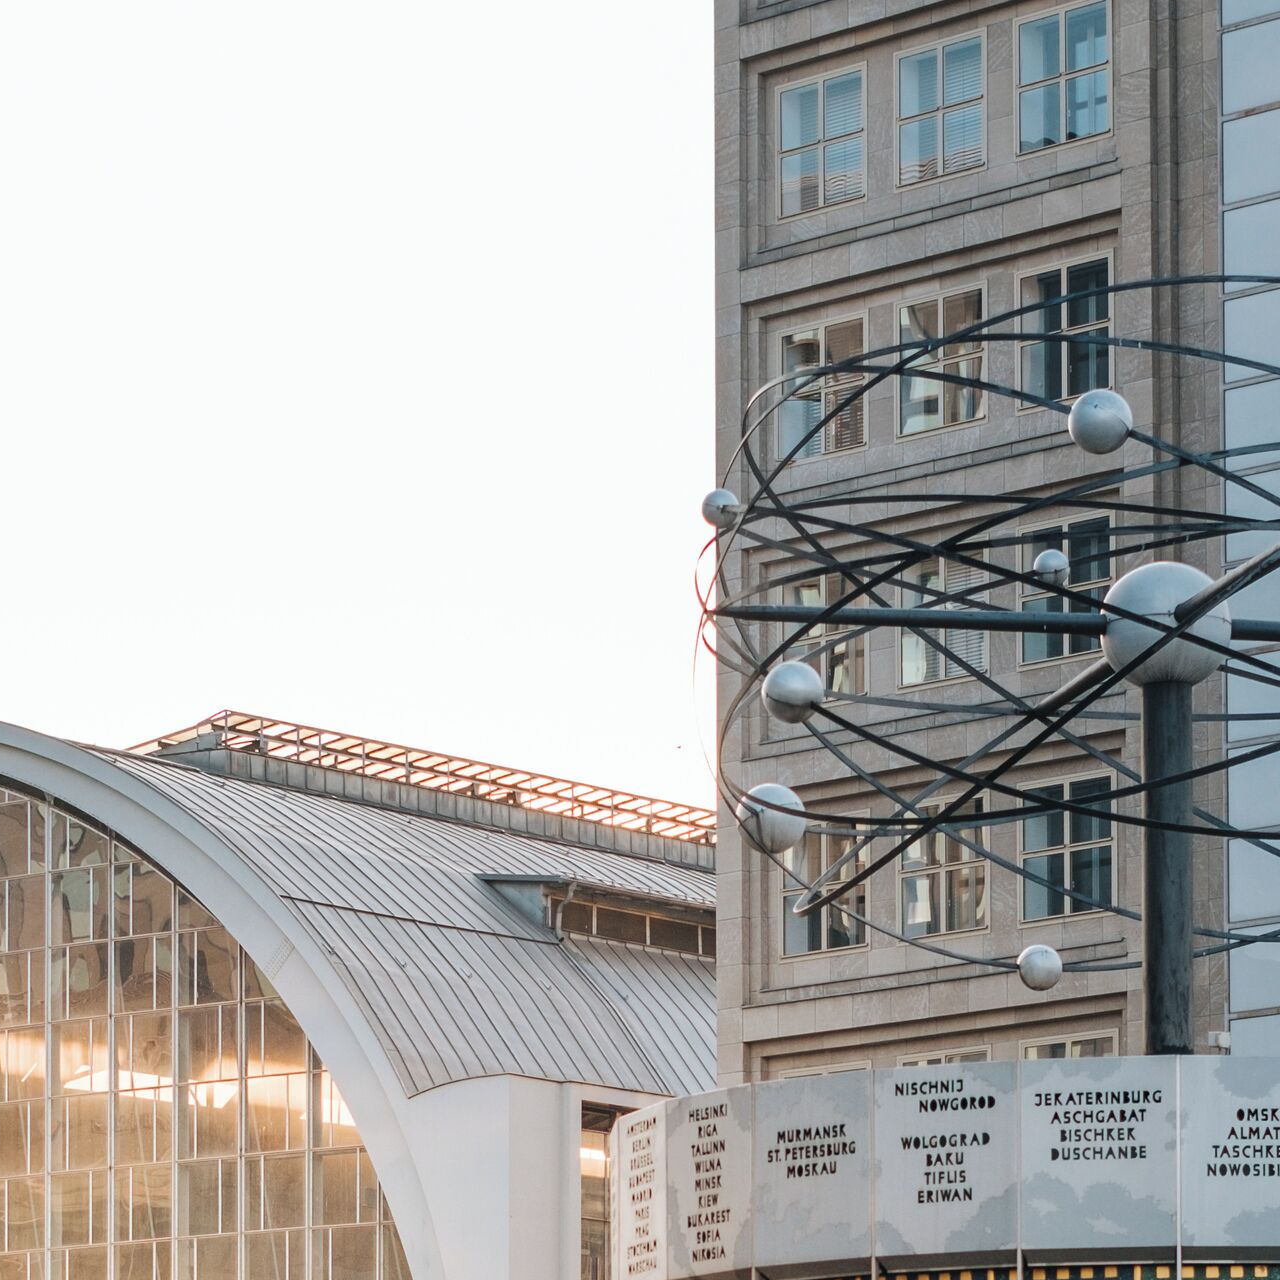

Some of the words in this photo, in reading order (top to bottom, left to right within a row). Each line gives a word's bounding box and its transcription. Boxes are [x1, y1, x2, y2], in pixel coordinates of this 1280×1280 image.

[895, 1079, 964, 1097] NISCHNIJ
[919, 1095, 996, 1113] NOWGOROD
[1034, 1089, 1162, 1107] JEKATERINBURG
[688, 1104, 728, 1122] HELSINKI
[1050, 1109, 1147, 1125] ASCHGABAT
[1237, 1108, 1280, 1122] OMSK
[698, 1126, 718, 1139] RIGA
[776, 1124, 847, 1144] MURMANSK
[901, 1132, 990, 1150] WOLGOGRAD
[1060, 1127, 1136, 1142] BISCHKEK
[691, 1140, 726, 1157] TALLINN
[767, 1149, 782, 1163] ST.
[785, 1141, 856, 1161] PETERSBURG
[1050, 1145, 1147, 1161] DUSCHANBE
[695, 1159, 722, 1174] WILNA
[926, 1152, 964, 1167] BAKU
[786, 1161, 837, 1179] MOSKAU
[924, 1170, 966, 1185] TIFLIS
[695, 1175, 722, 1192] MINSK
[698, 1193, 719, 1209] KIEW
[917, 1188, 973, 1204] ERIWAN
[687, 1209, 731, 1229] BUKAREST
[697, 1229, 721, 1244] SOFIA
[692, 1246, 726, 1263] NIKOSIA
